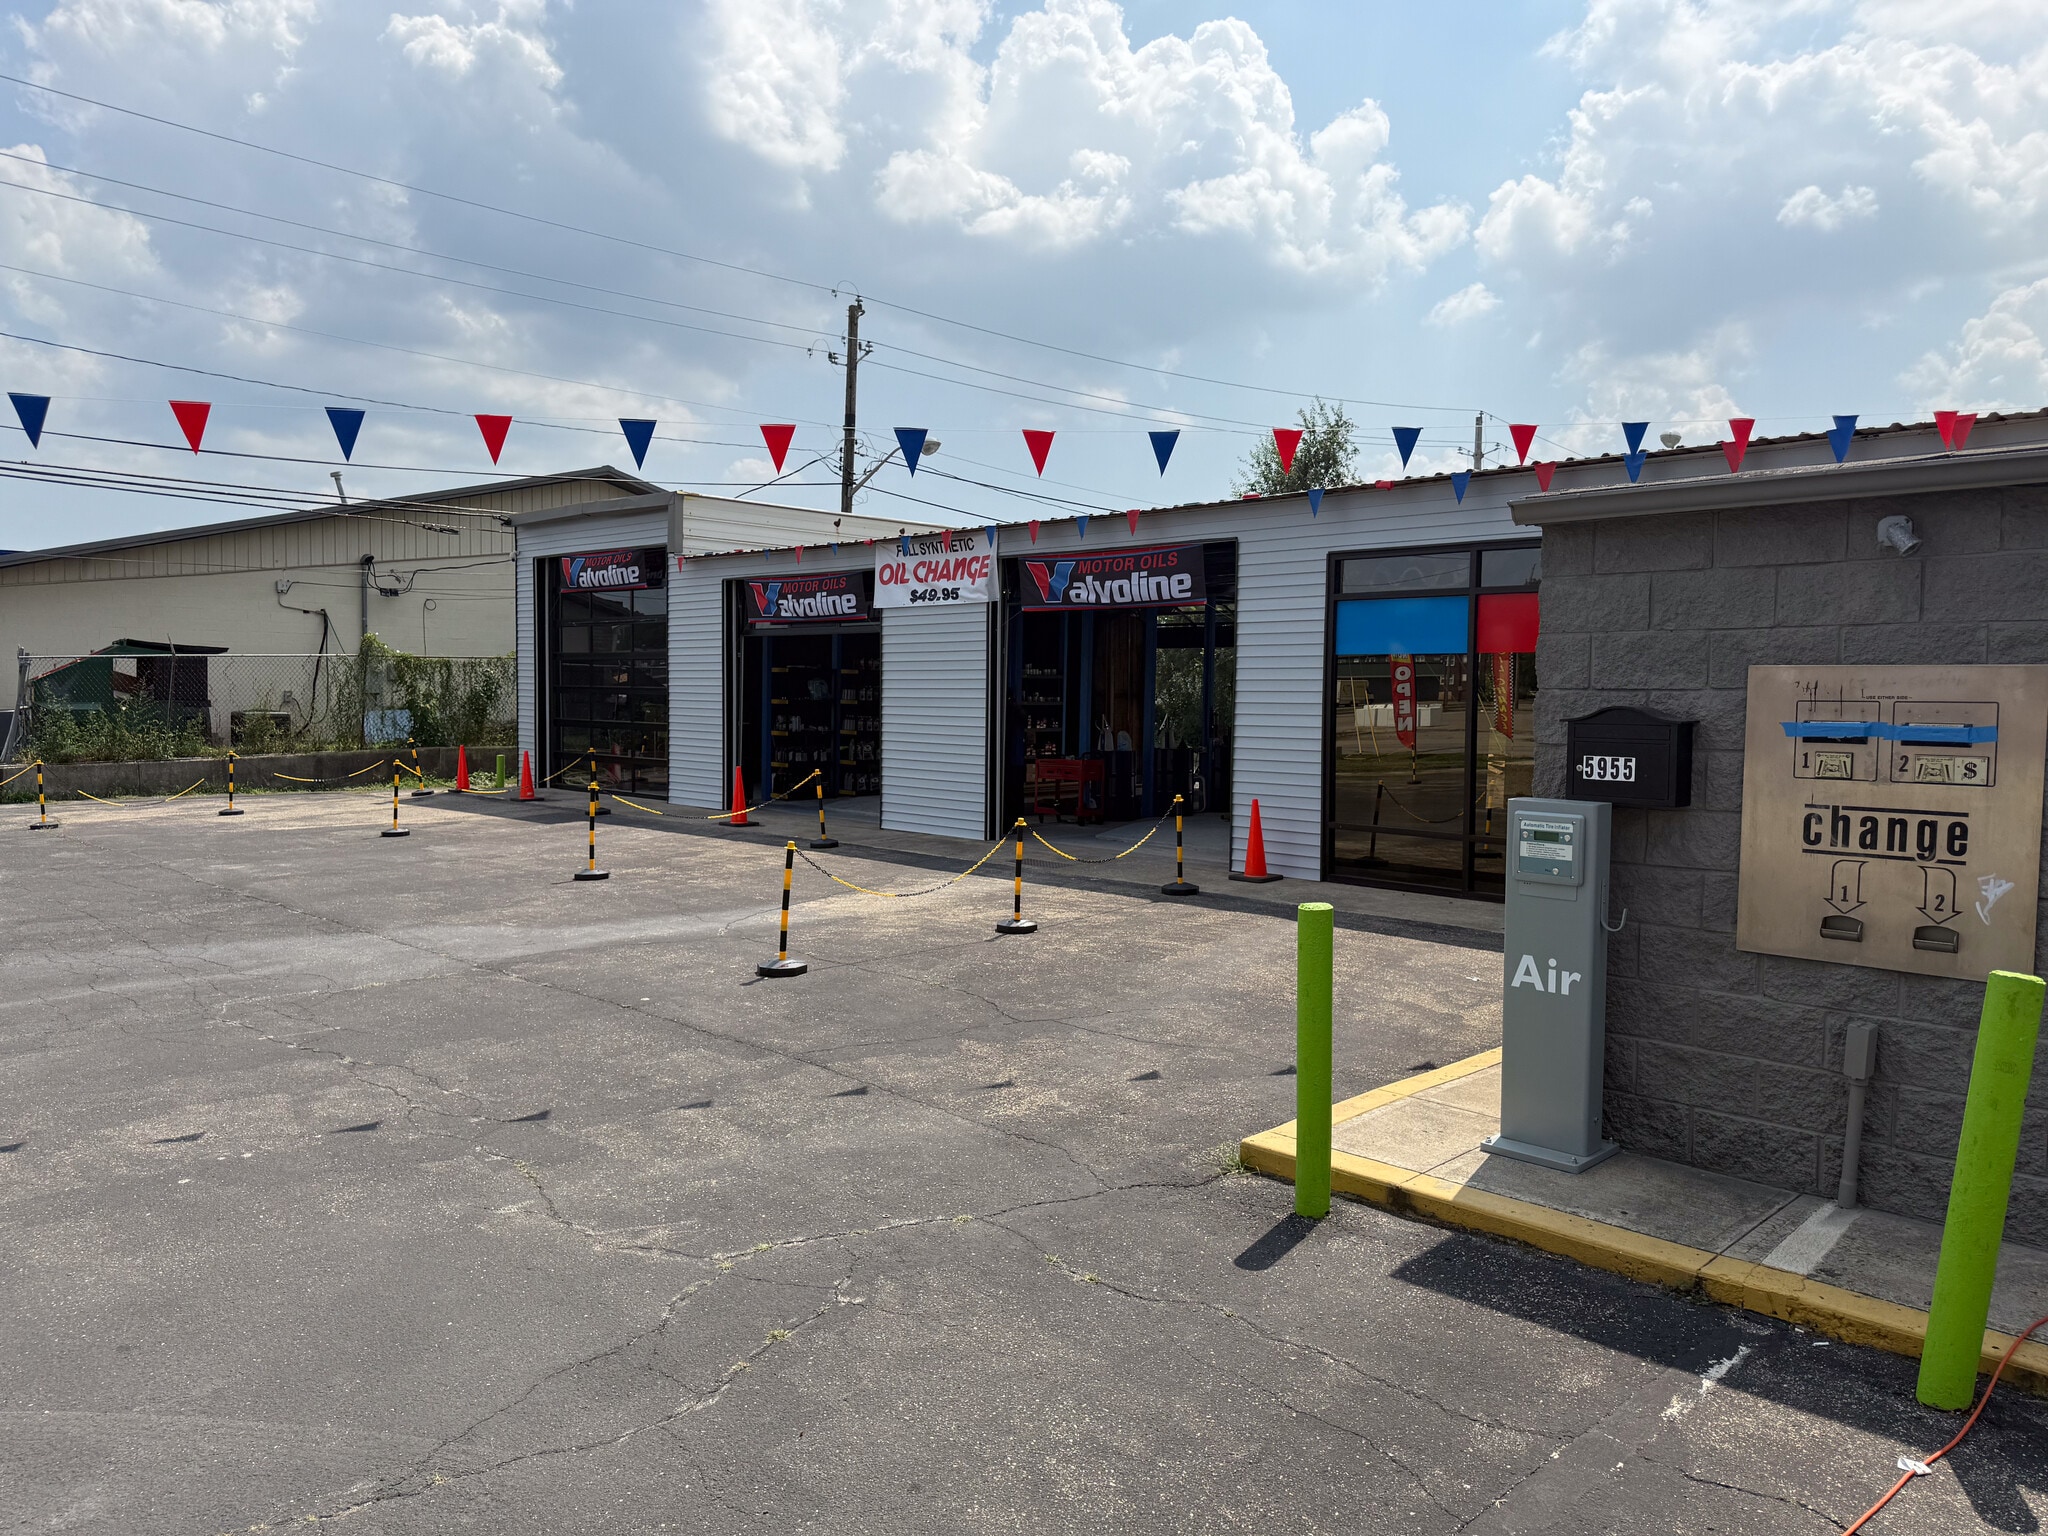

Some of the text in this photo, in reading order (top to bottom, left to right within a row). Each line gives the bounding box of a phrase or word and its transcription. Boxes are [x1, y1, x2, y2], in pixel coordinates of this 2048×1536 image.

[920, 538, 975, 555] SYNTETIC
[585, 552, 632, 567] MOTOR OILS
[1077, 552, 1178, 574] MOTOR OILS
[562, 557, 640, 588] Valvoline
[879, 554, 991, 586] OIL CHANGE
[782, 577, 847, 593] MOTOR OILS
[1025, 561, 1192, 604] Valvoline
[749, 583, 857, 617] Valvoline
[909, 587, 960, 604] $49.95
[1585, 756, 1634, 780] 5955
[1802, 752, 1810, 768] 1
[1899, 755, 1909, 772] 2
[1803, 805, 1969, 862] change
[1840, 885, 1849, 902] 1
[1934, 895, 1945, 912] 2
[1511, 954, 1582, 996] Air
